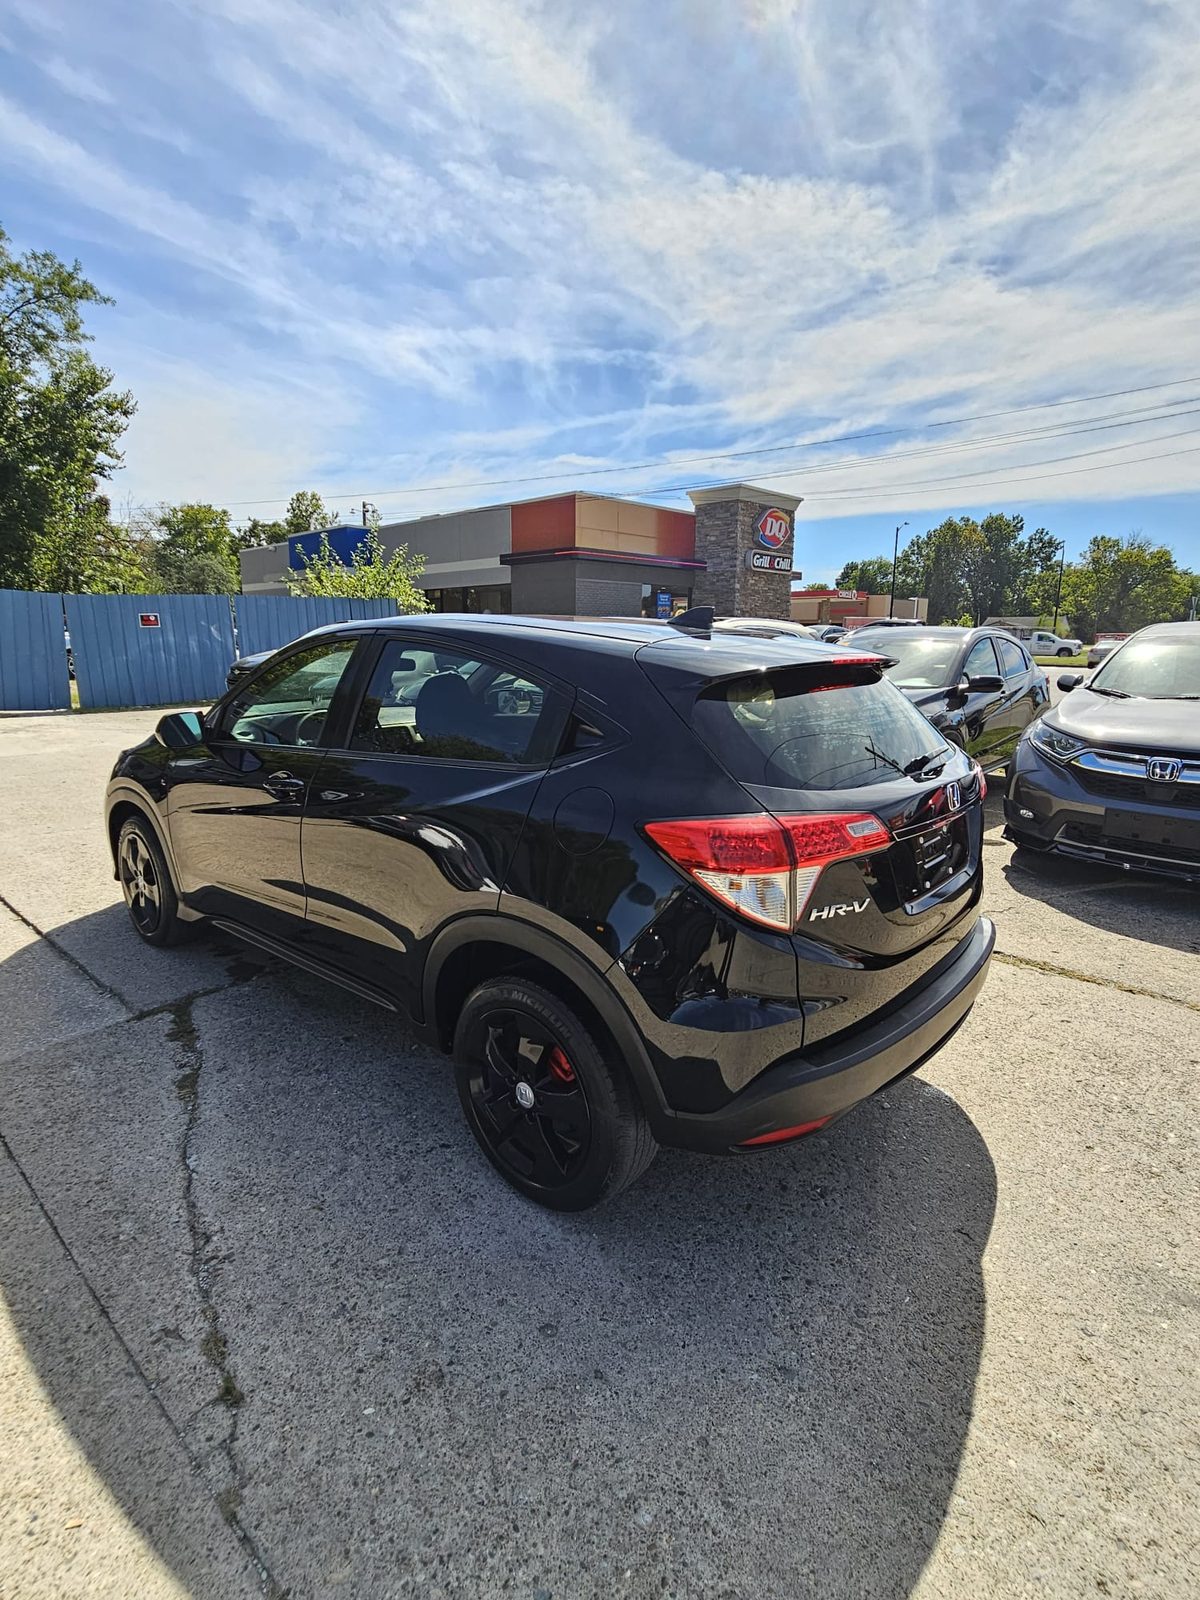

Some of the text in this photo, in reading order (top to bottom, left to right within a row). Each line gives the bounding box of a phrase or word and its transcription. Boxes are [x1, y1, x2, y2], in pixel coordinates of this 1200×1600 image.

[765, 517, 786, 541] DQ
[753, 554, 770, 568] Grill
[774, 557, 791, 570] Chill
[809, 898, 871, 922] HR-V
